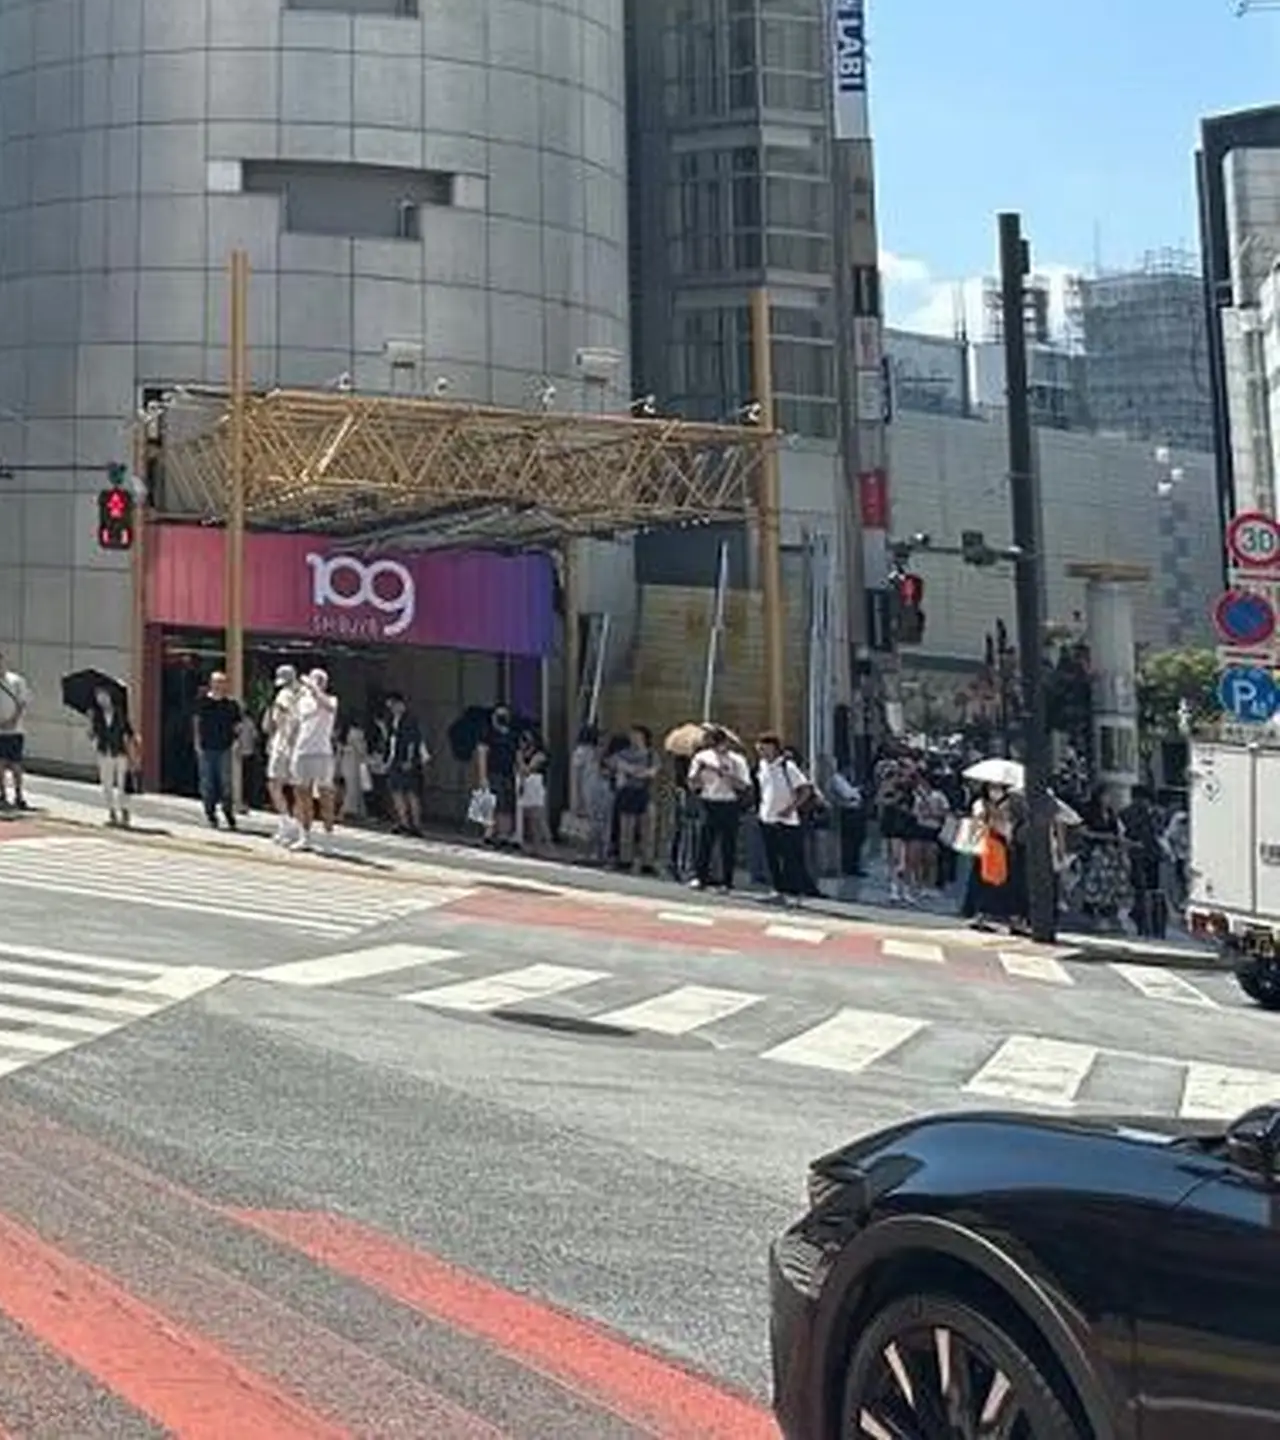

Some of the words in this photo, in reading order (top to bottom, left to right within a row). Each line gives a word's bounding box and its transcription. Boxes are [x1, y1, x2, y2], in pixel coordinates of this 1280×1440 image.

[837, 18, 863, 85] LABI
[1241, 526, 1274, 554] 30
[305, 551, 416, 637] 109
